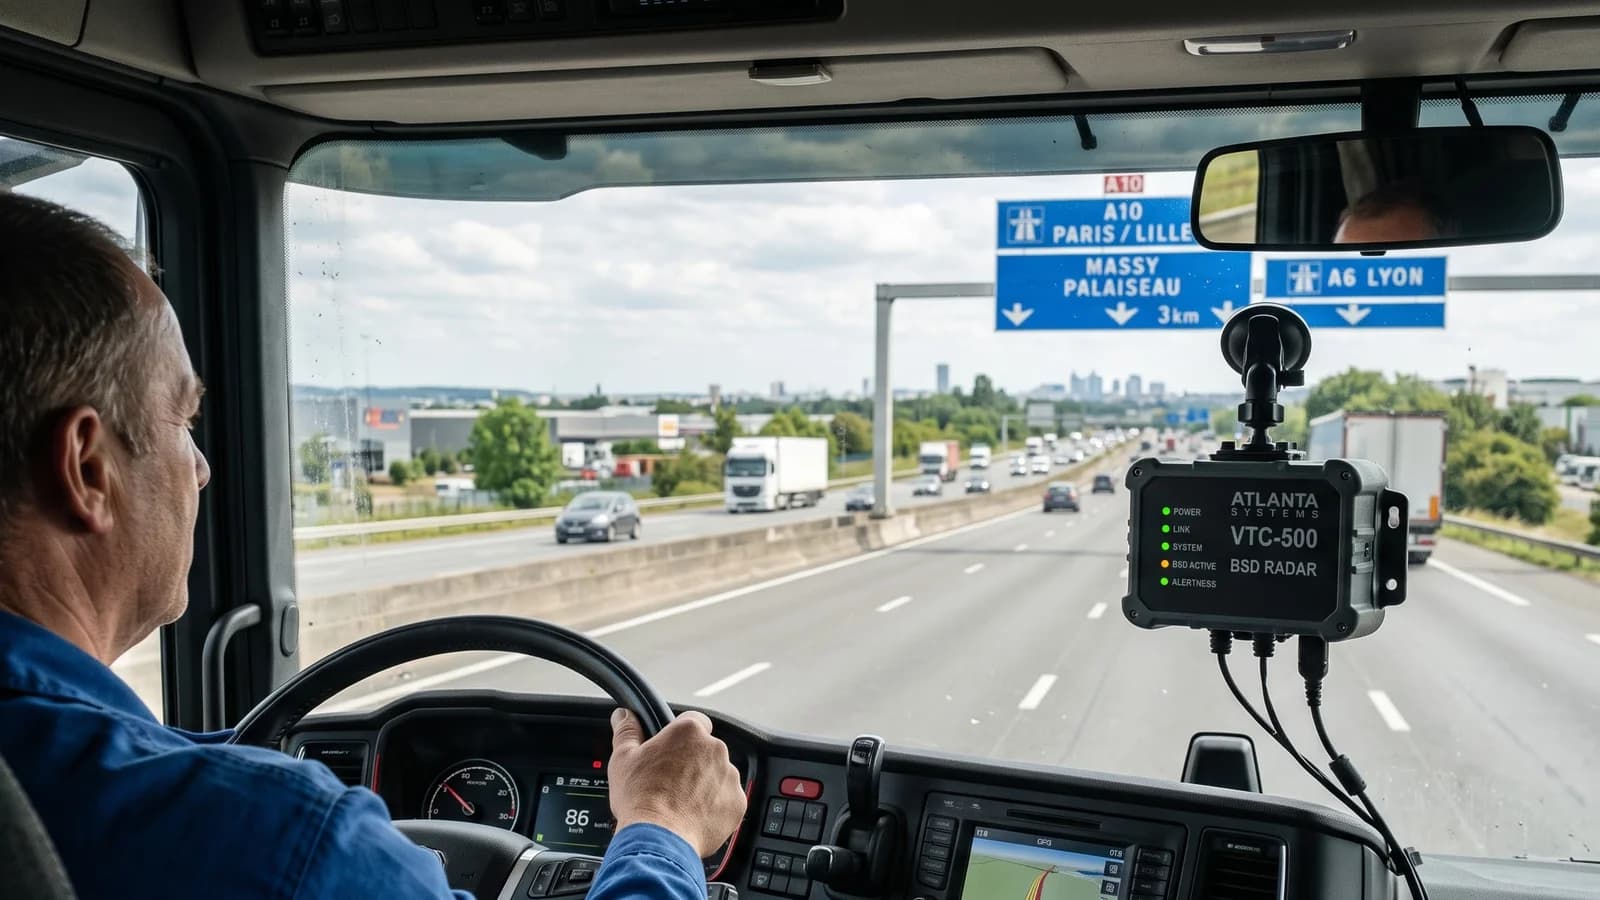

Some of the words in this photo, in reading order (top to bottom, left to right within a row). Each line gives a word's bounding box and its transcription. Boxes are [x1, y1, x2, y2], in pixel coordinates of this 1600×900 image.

[1105, 176, 1142, 192] A10
[1104, 202, 1143, 220] A10
[1053, 225, 1115, 243] PARIS
[1121, 224, 1131, 243] /
[1136, 223, 1193, 242] LILLE
[1086, 257, 1159, 275] MASSY
[1328, 267, 1357, 287] A6
[1367, 266, 1423, 287] LYON
[1064, 278, 1181, 297] PALAISEAU
[1231, 491, 1319, 508] ATLANTA
[1173, 507, 1201, 516] POWER
[1231, 508, 1319, 518] SYSTEMS
[1173, 525, 1190, 533] LINK
[1230, 525, 1318, 548] VTC-500
[1172, 543, 1203, 552] SYSTEM
[1172, 560, 1188, 569] BSD
[1189, 561, 1216, 570] ACTIVE
[1230, 558, 1260, 574] BSD
[1264, 560, 1317, 577] RADAR
[1171, 578, 1217, 588] ALERTNESS
[565, 809, 590, 826] 86
